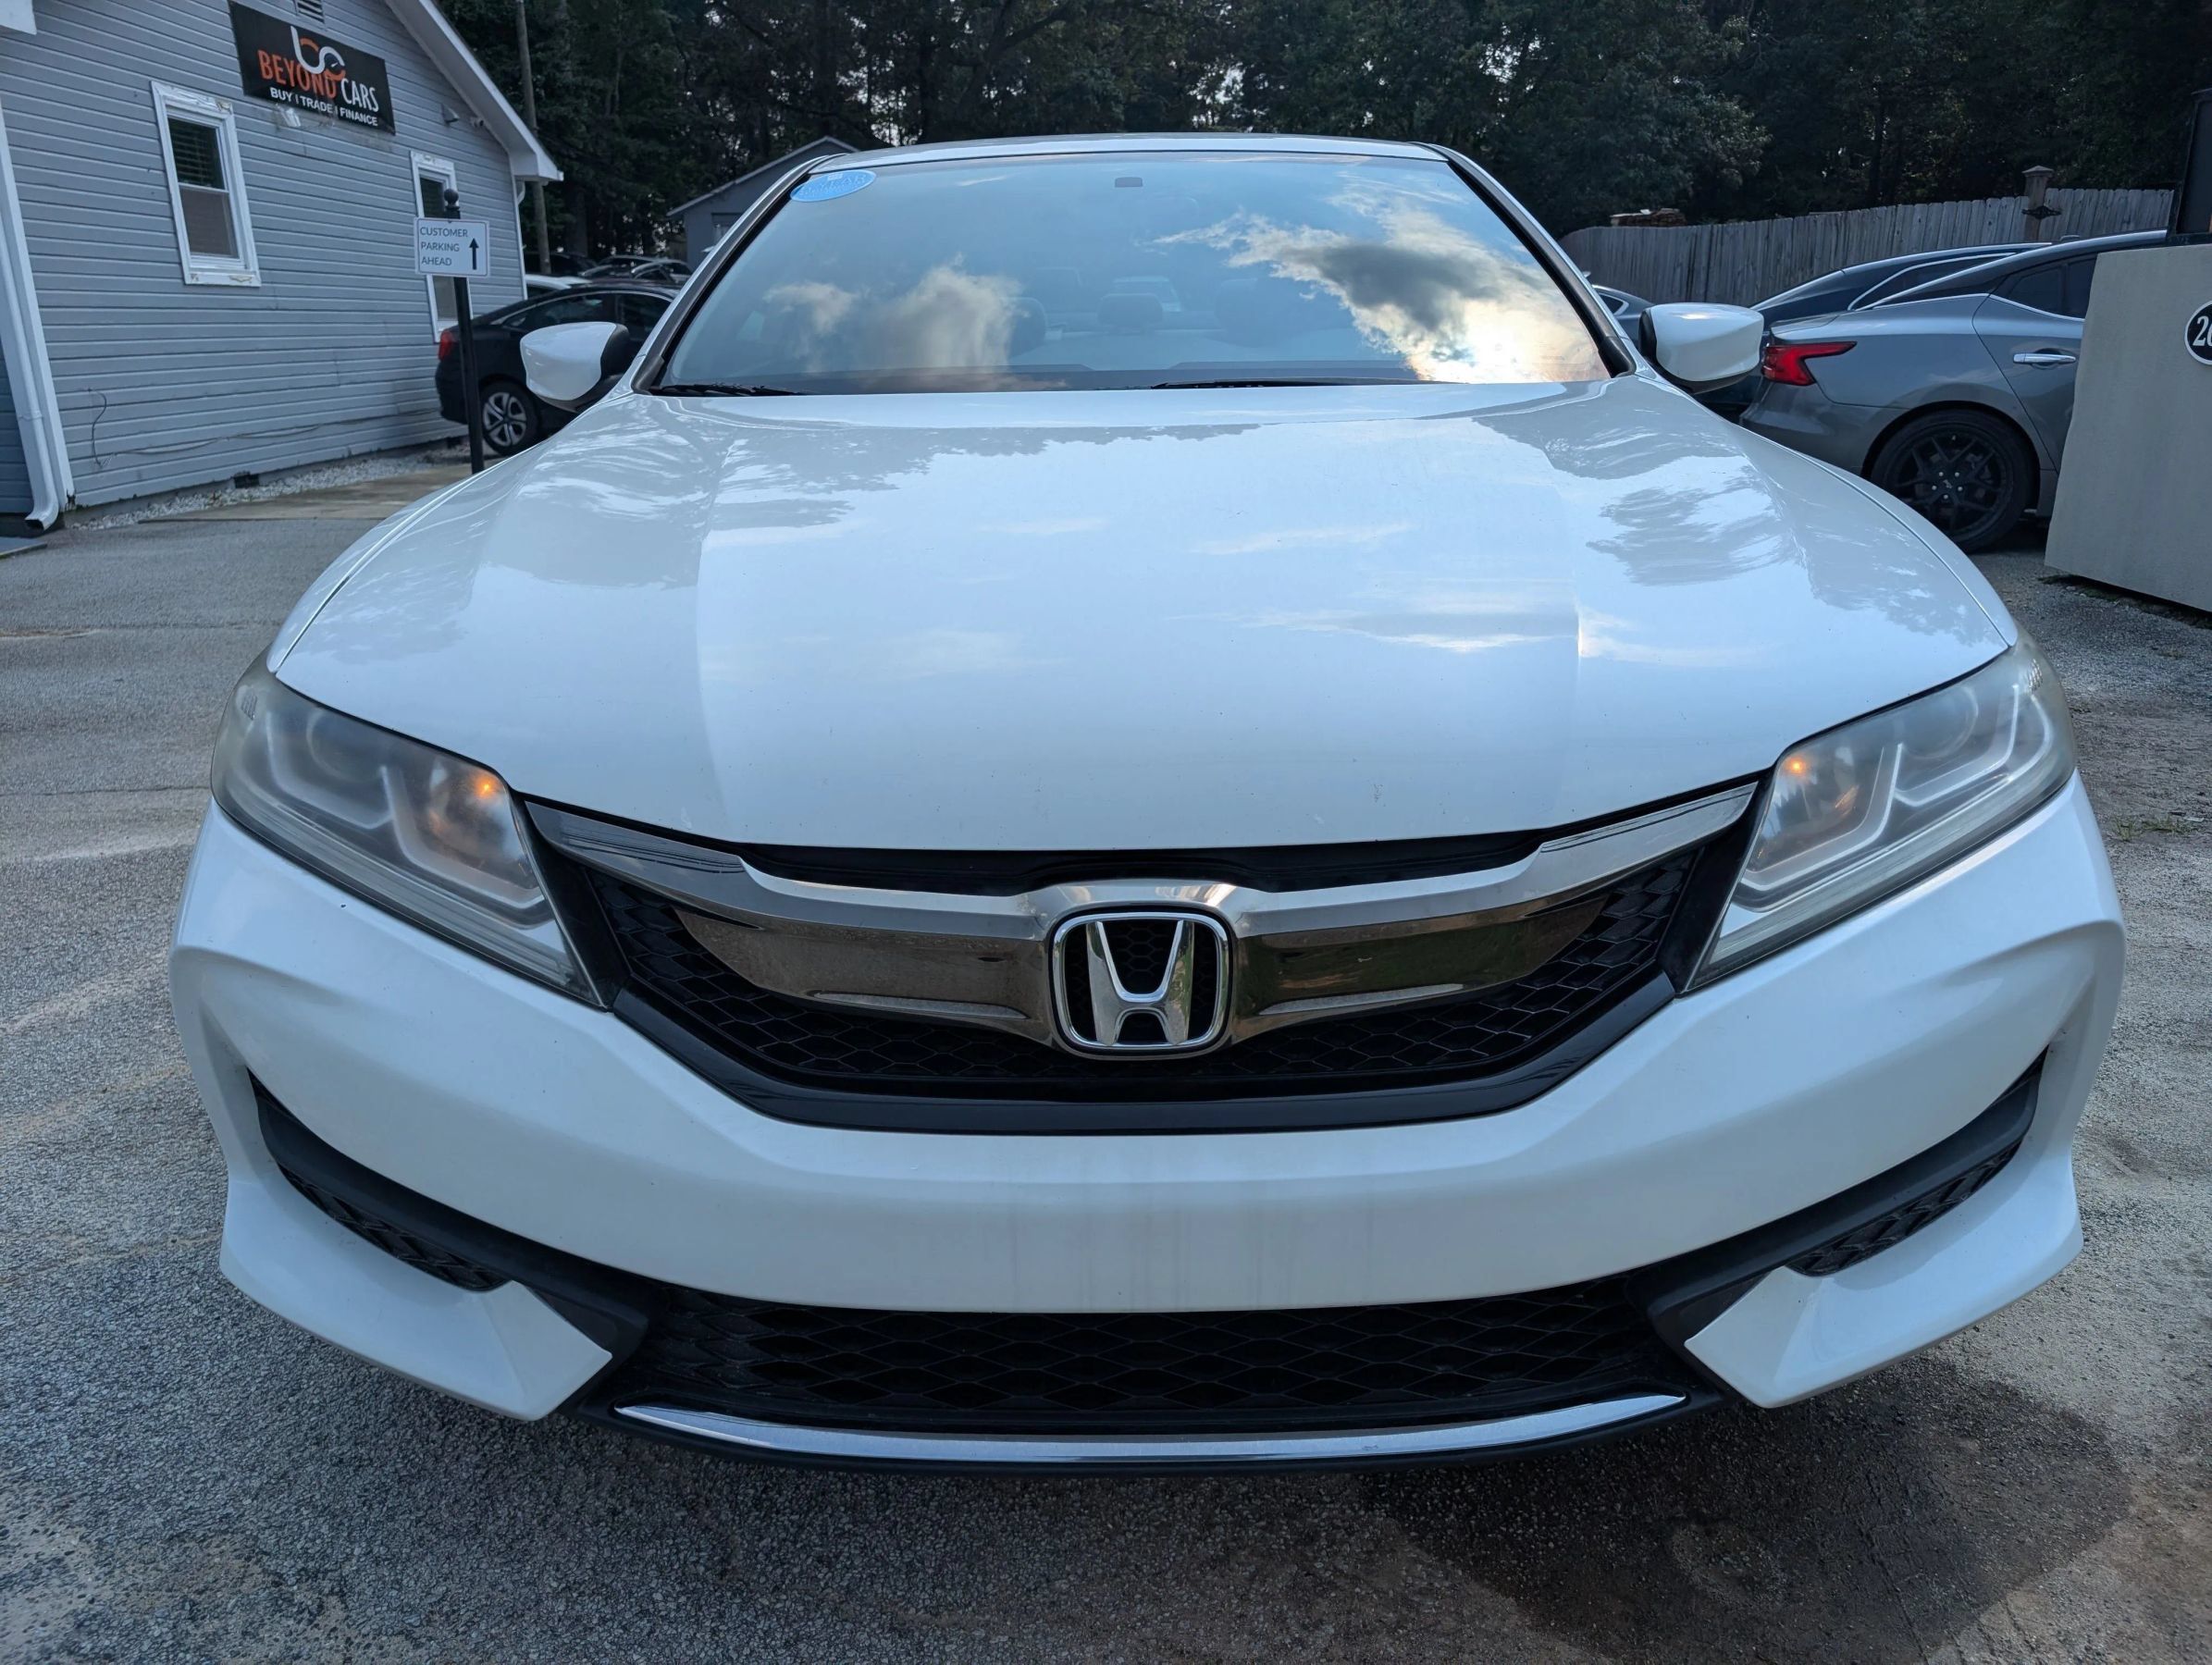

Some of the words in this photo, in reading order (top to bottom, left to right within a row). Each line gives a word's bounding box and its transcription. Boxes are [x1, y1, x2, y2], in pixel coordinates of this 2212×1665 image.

[257, 49, 337, 99] BEYOND
[340, 78, 379, 113] CARS
[269, 87, 293, 102] BUY
[300, 95, 333, 114] TRADE
[340, 107, 378, 127] FINANCE
[420, 227, 468, 238] CUSTOMER
[421, 241, 460, 253] PARKING
[421, 256, 452, 266] AHEAD
